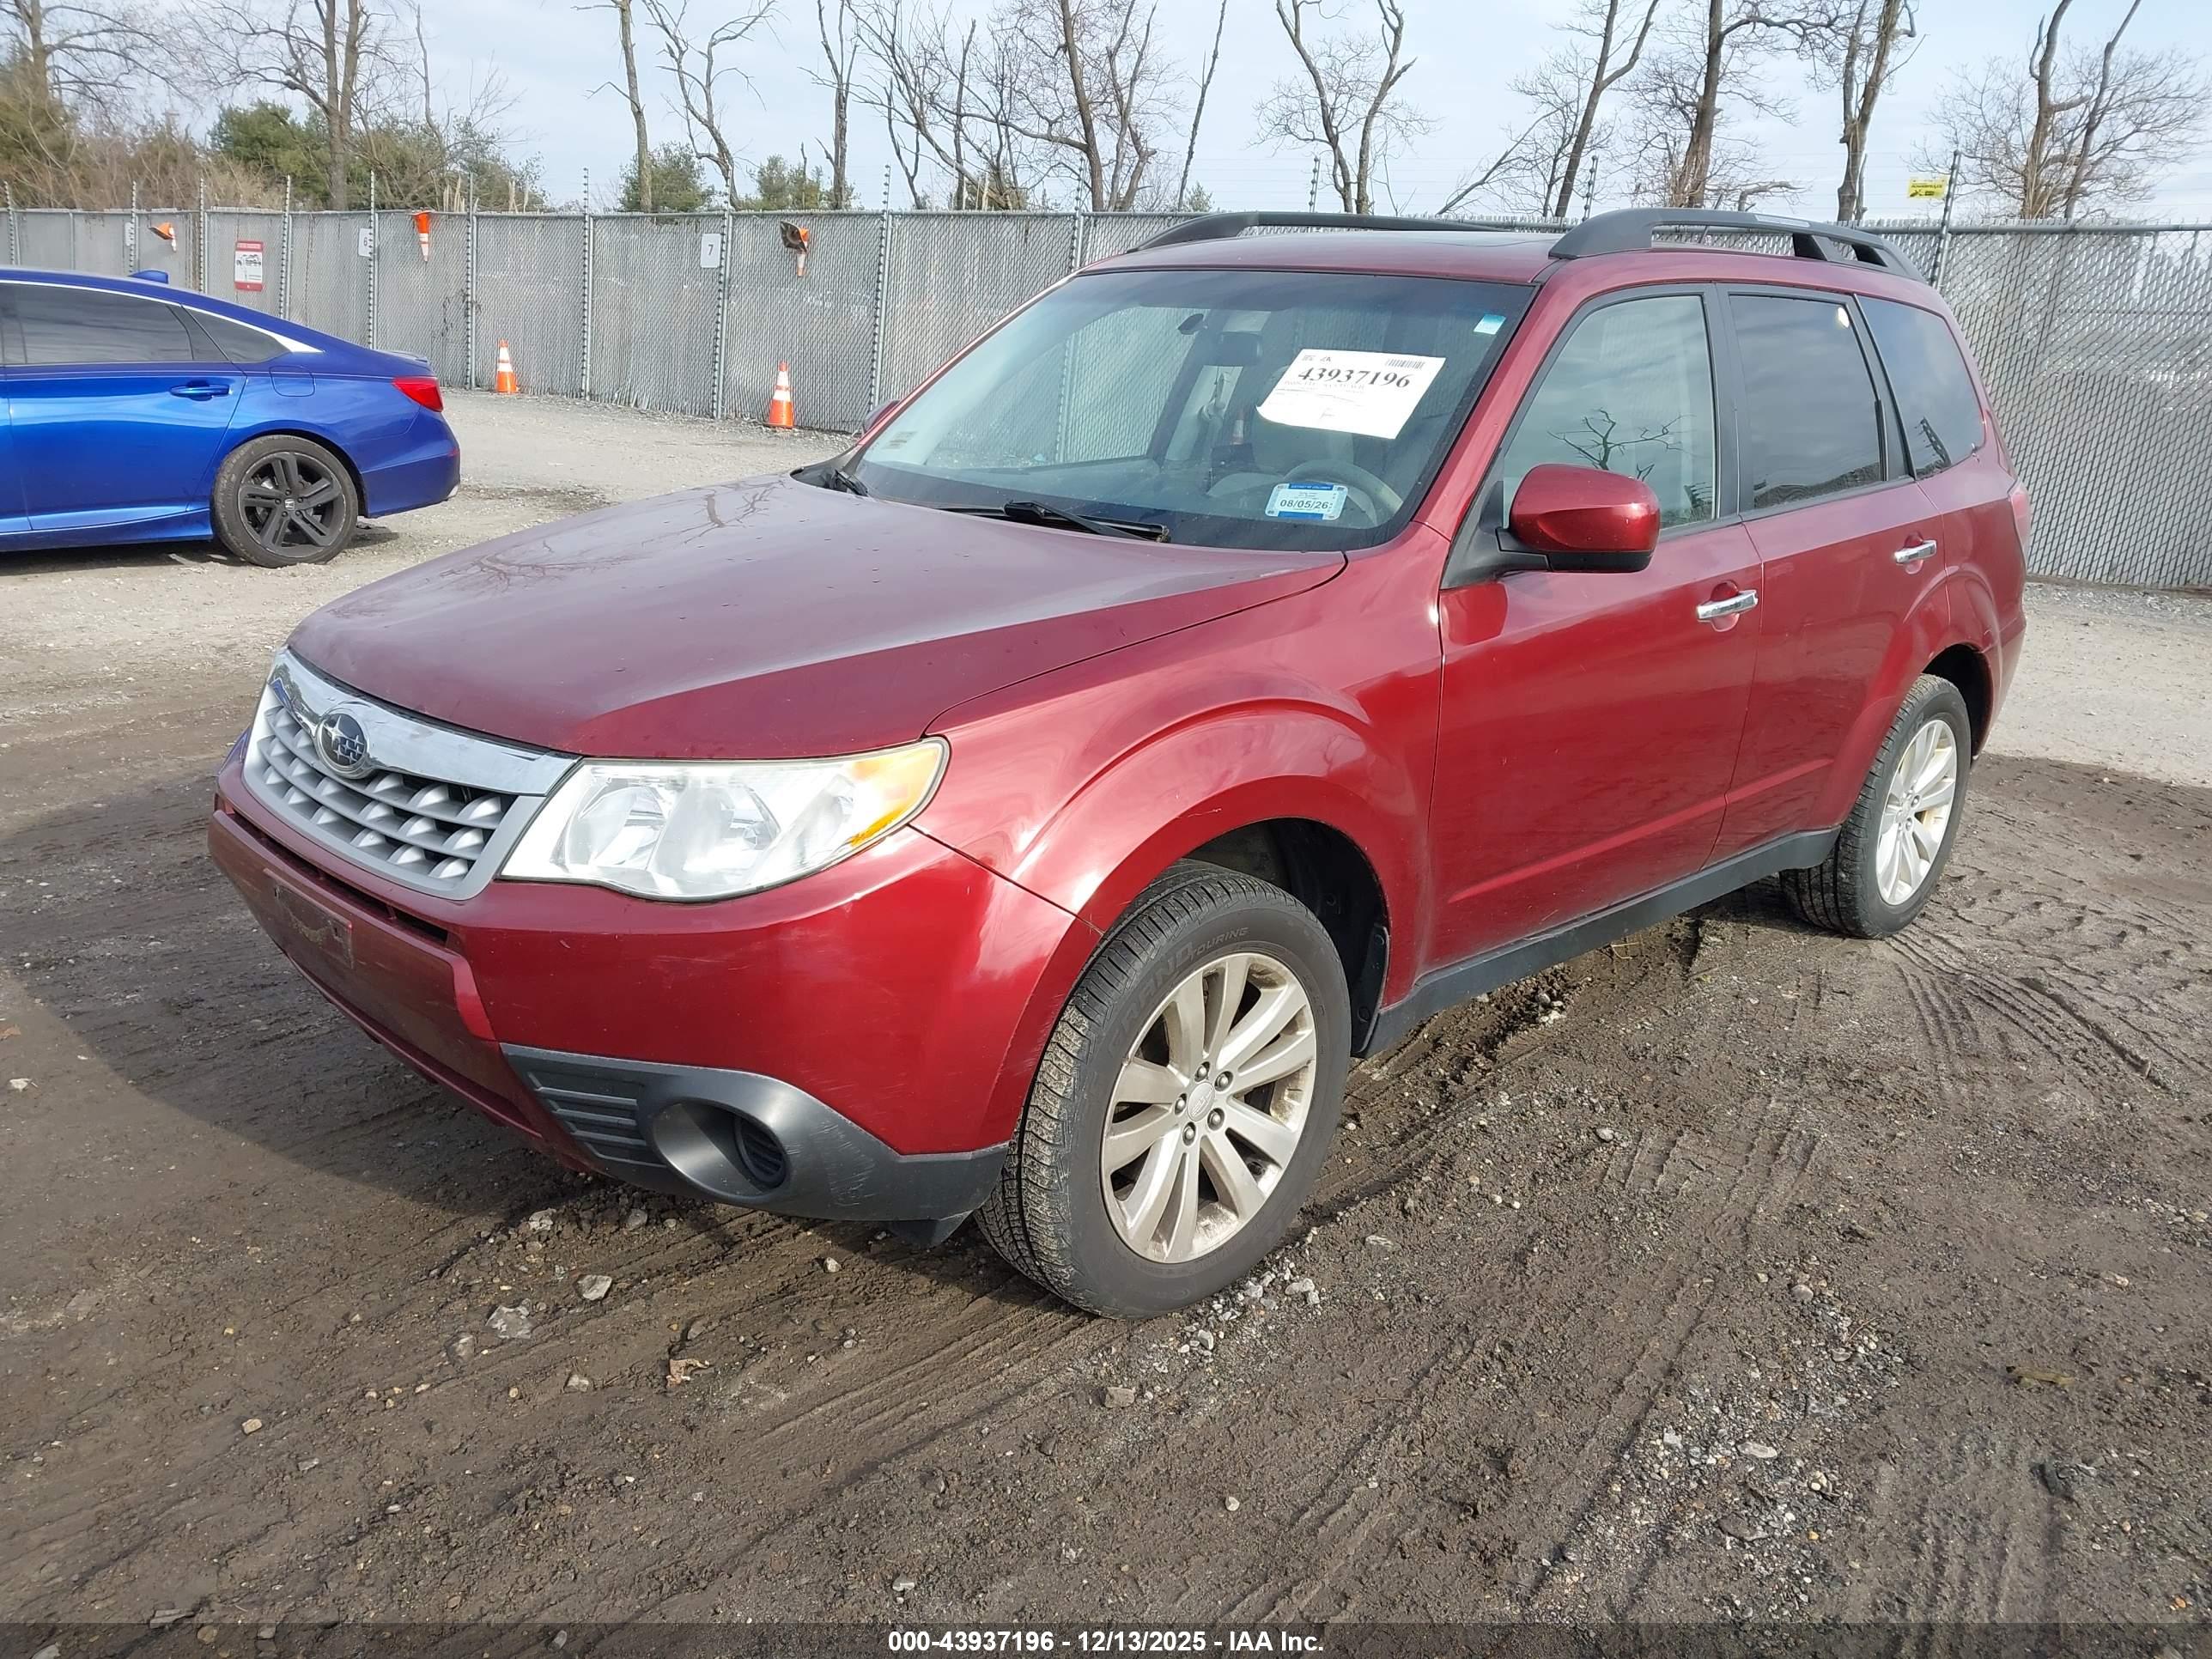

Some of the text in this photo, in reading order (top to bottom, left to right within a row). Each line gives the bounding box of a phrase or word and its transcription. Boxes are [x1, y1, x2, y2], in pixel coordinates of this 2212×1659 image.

[708, 244, 714, 256] 7
[1298, 367, 1414, 388] 43937196
[1279, 499, 1329, 509] 08/05/26
